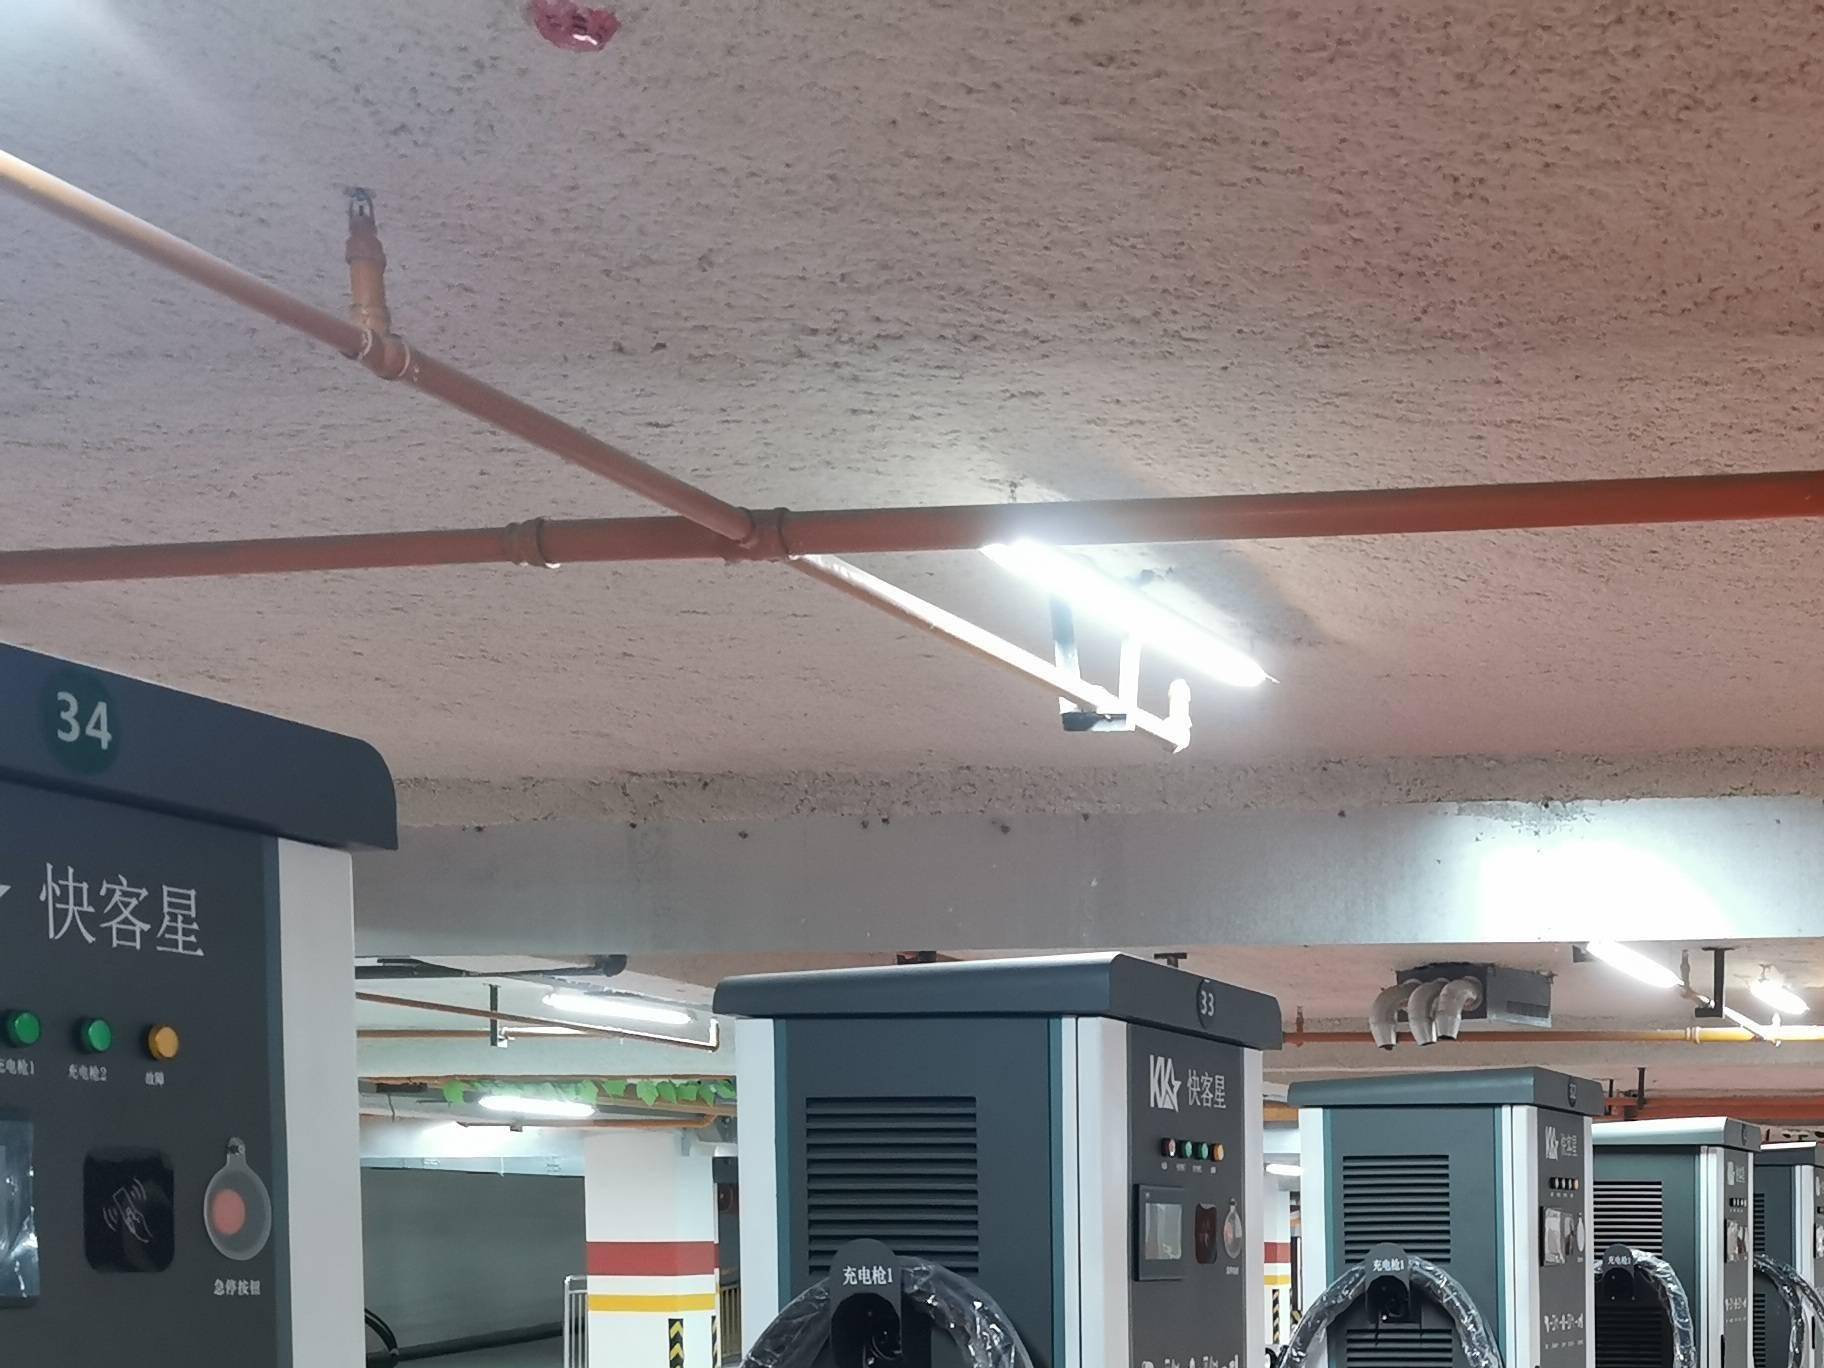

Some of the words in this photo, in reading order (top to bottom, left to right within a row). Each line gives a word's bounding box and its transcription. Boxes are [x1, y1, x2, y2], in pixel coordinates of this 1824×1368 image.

[56, 690, 112, 750] 34
[39, 861, 205, 957] 快客星
[1200, 990, 1215, 1016] 33
[1186, 1067, 1227, 1110] 快客星
[213, 1278, 262, 1297] 急停按钮
[842, 1265, 894, 1286] 充电枪1
